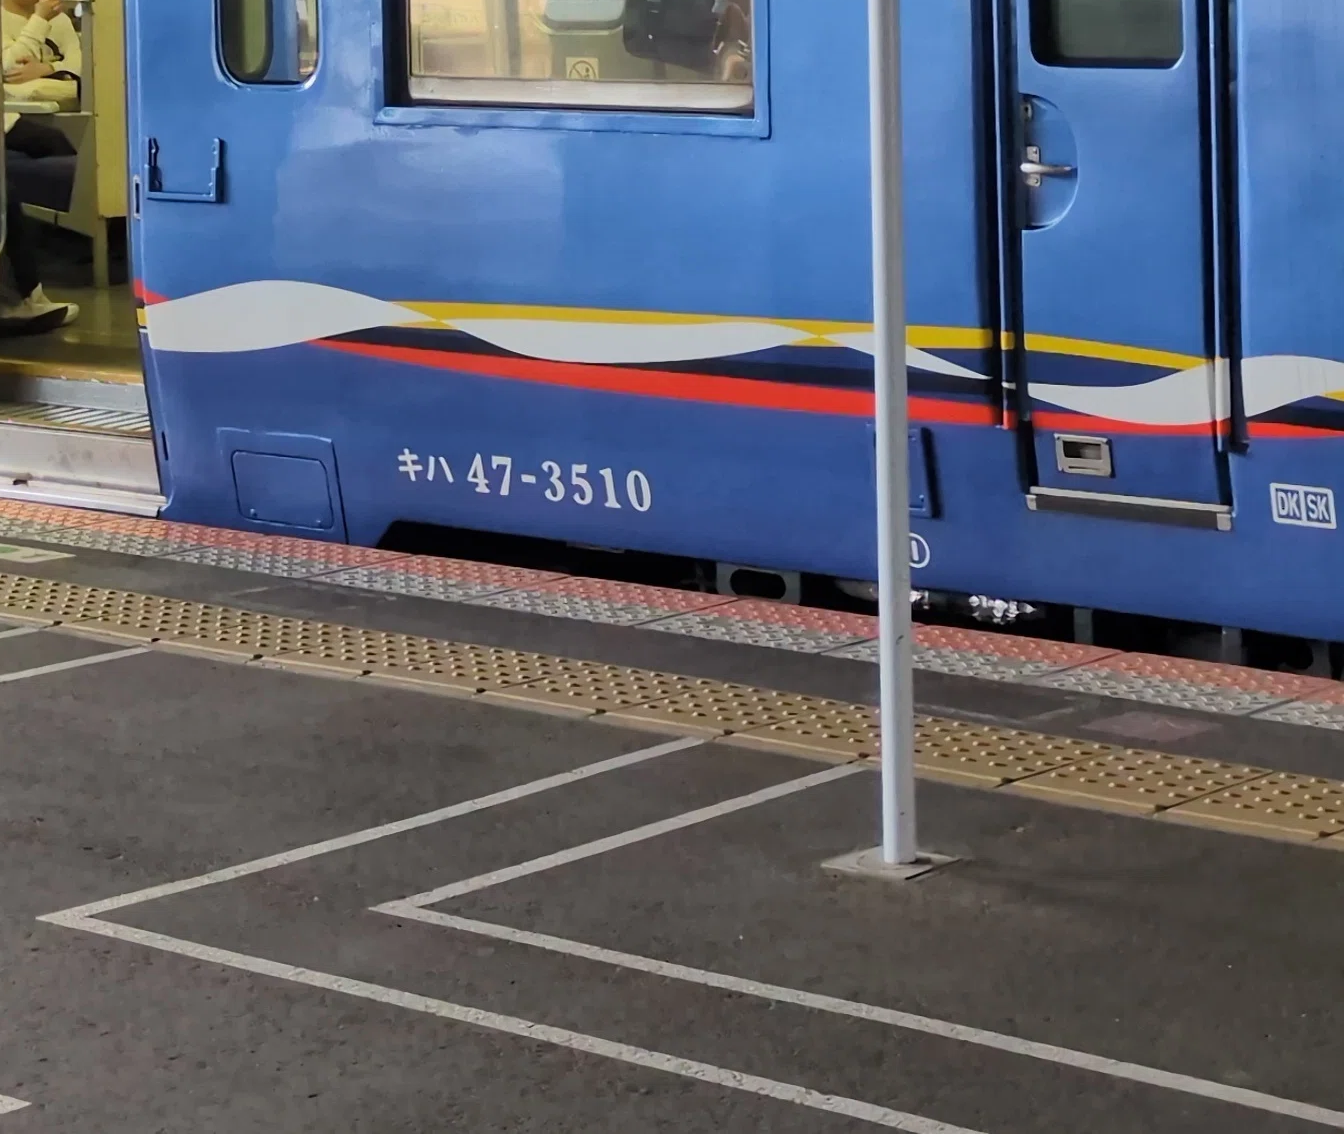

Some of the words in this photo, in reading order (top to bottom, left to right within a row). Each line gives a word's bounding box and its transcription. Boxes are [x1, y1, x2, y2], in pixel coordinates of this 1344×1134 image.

[398, 446, 454, 483] キハ
[467, 453, 652, 512] 47-3510
[1277, 491, 1301, 518] DK
[1306, 493, 1330, 521] SK
